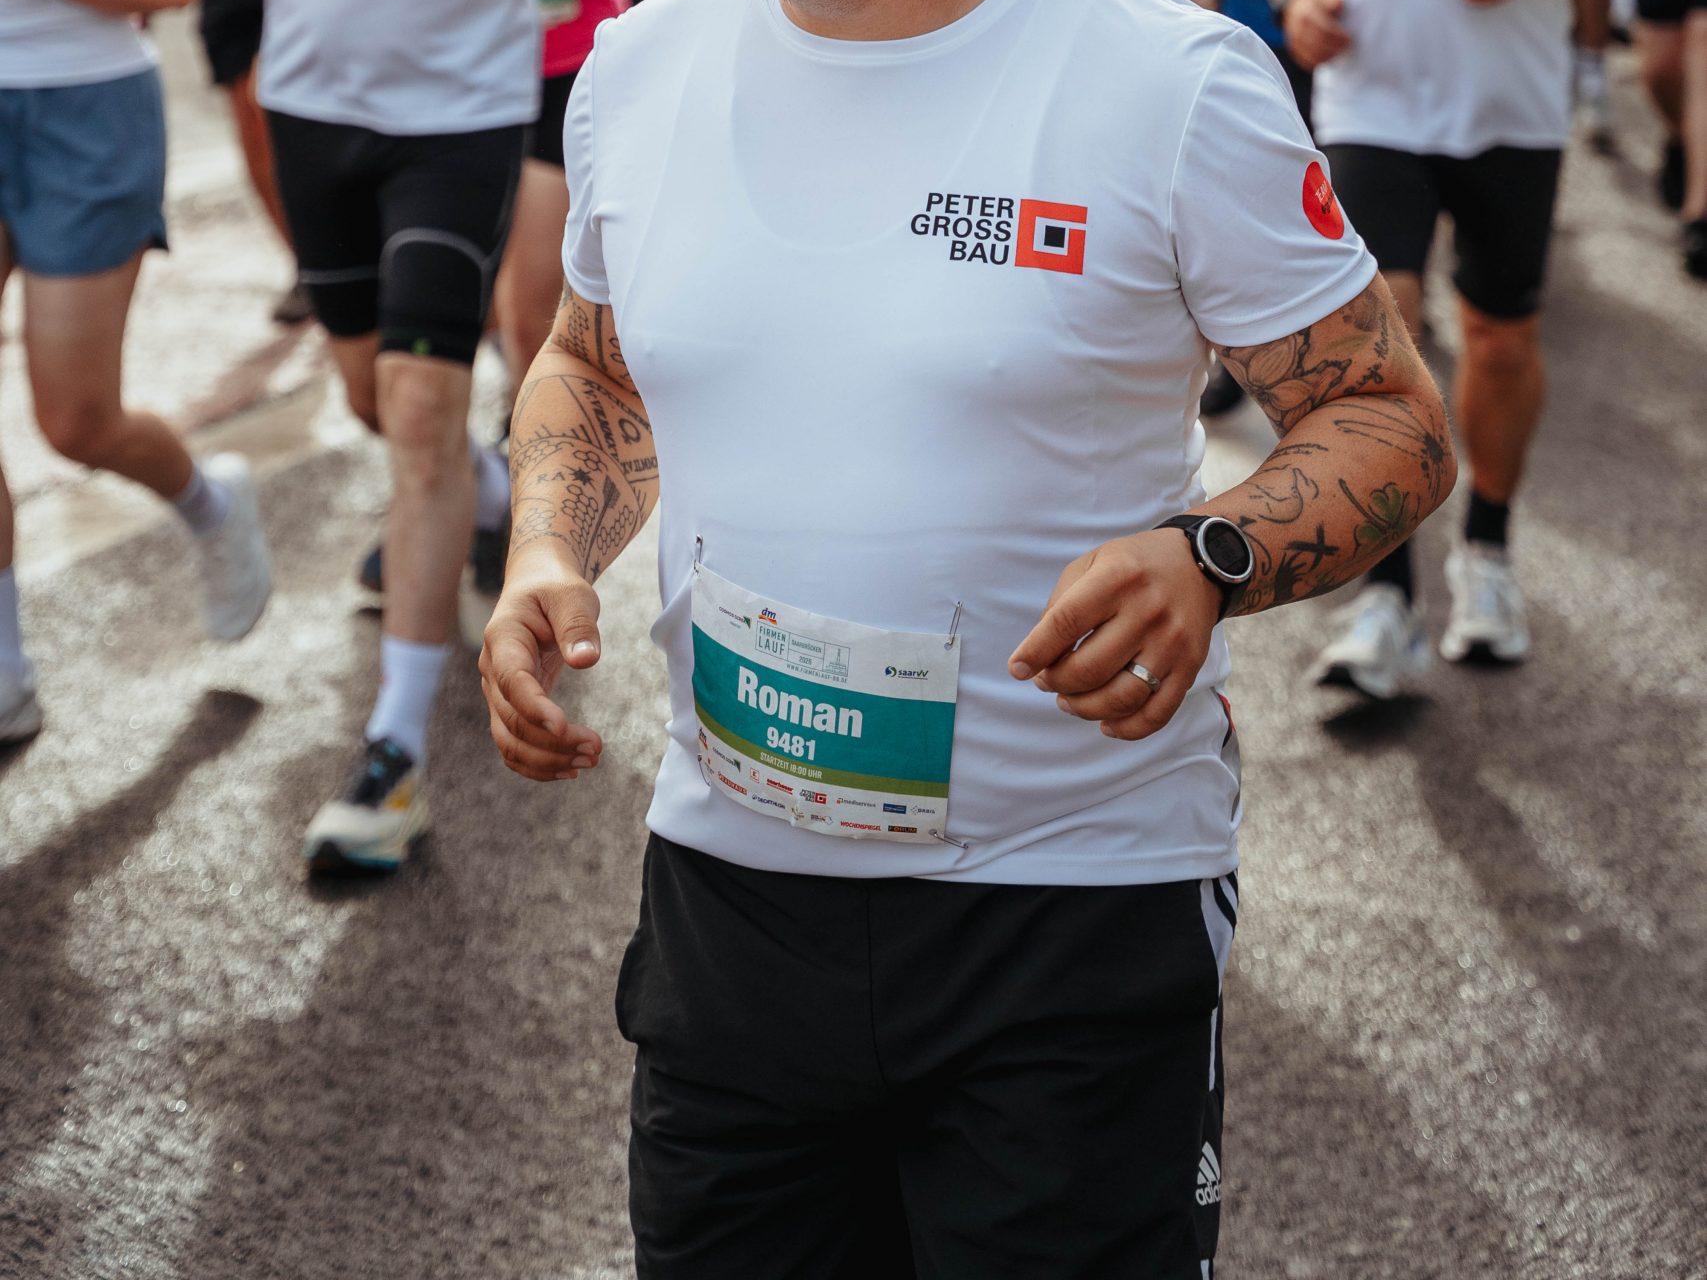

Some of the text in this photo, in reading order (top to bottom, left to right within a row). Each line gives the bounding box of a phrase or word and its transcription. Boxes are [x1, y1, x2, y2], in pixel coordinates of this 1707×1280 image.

[925, 192, 1015, 219] PETER
[910, 213, 1012, 242] GROSS
[949, 239, 1010, 265] BAU
[761, 607, 777, 620] dm
[758, 636, 786, 656] LAUF
[759, 625, 787, 643] FIRMEN
[737, 665, 864, 738] Roman
[766, 726, 816, 761] 9481
[760, 751, 789, 771] STARTZEIT
[807, 767, 823, 780] UHR
[840, 820, 881, 832] WOCHENSPIEGEL
[1195, 1180, 1222, 1207] adid
